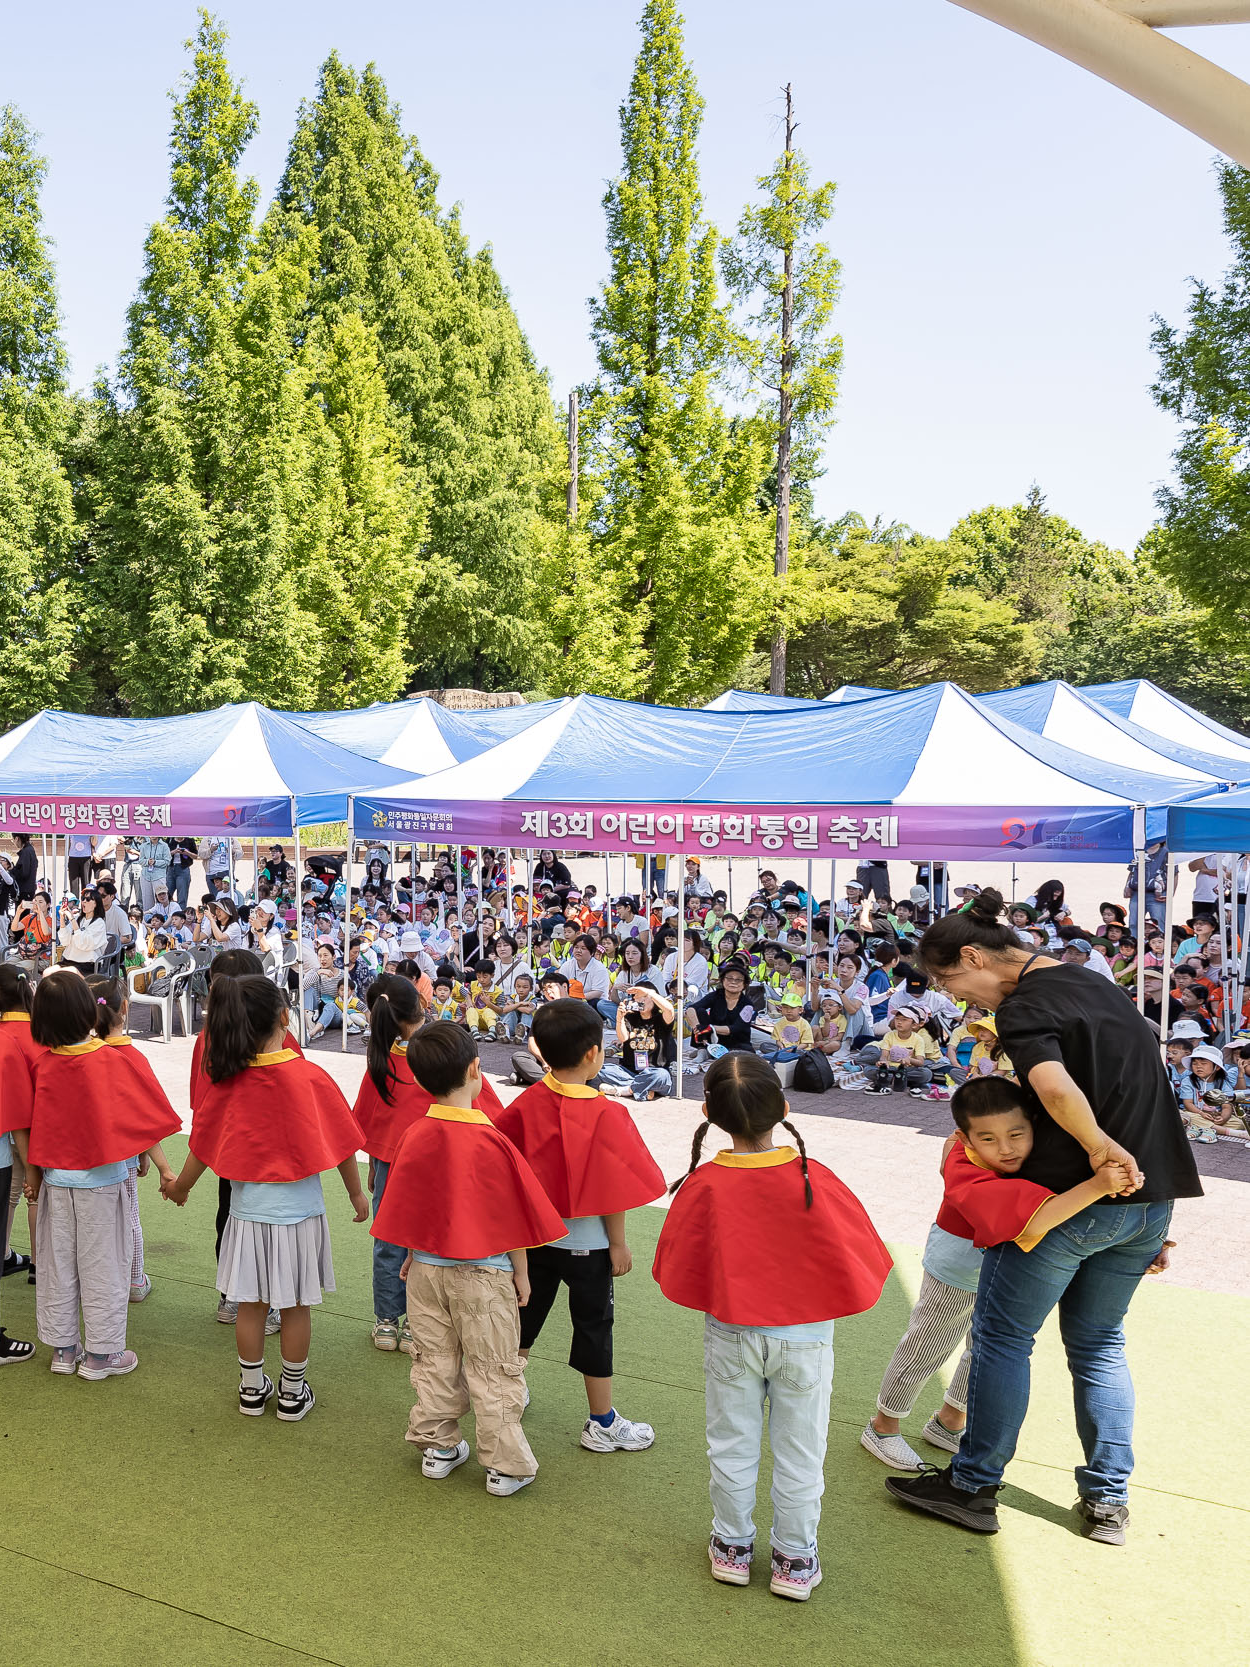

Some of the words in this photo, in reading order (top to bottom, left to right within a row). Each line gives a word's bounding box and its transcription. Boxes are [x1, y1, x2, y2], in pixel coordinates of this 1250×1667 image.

[9, 803, 57, 827] 어린이
[59, 803, 131, 830] 평화통일
[133, 804, 172, 830] 축제
[519, 810, 595, 840] 제3회
[599, 812, 685, 845] 어린이
[690, 813, 820, 851] 평화통일
[827, 815, 900, 851] 축제
[490, 1477, 501, 1485] NIKE
